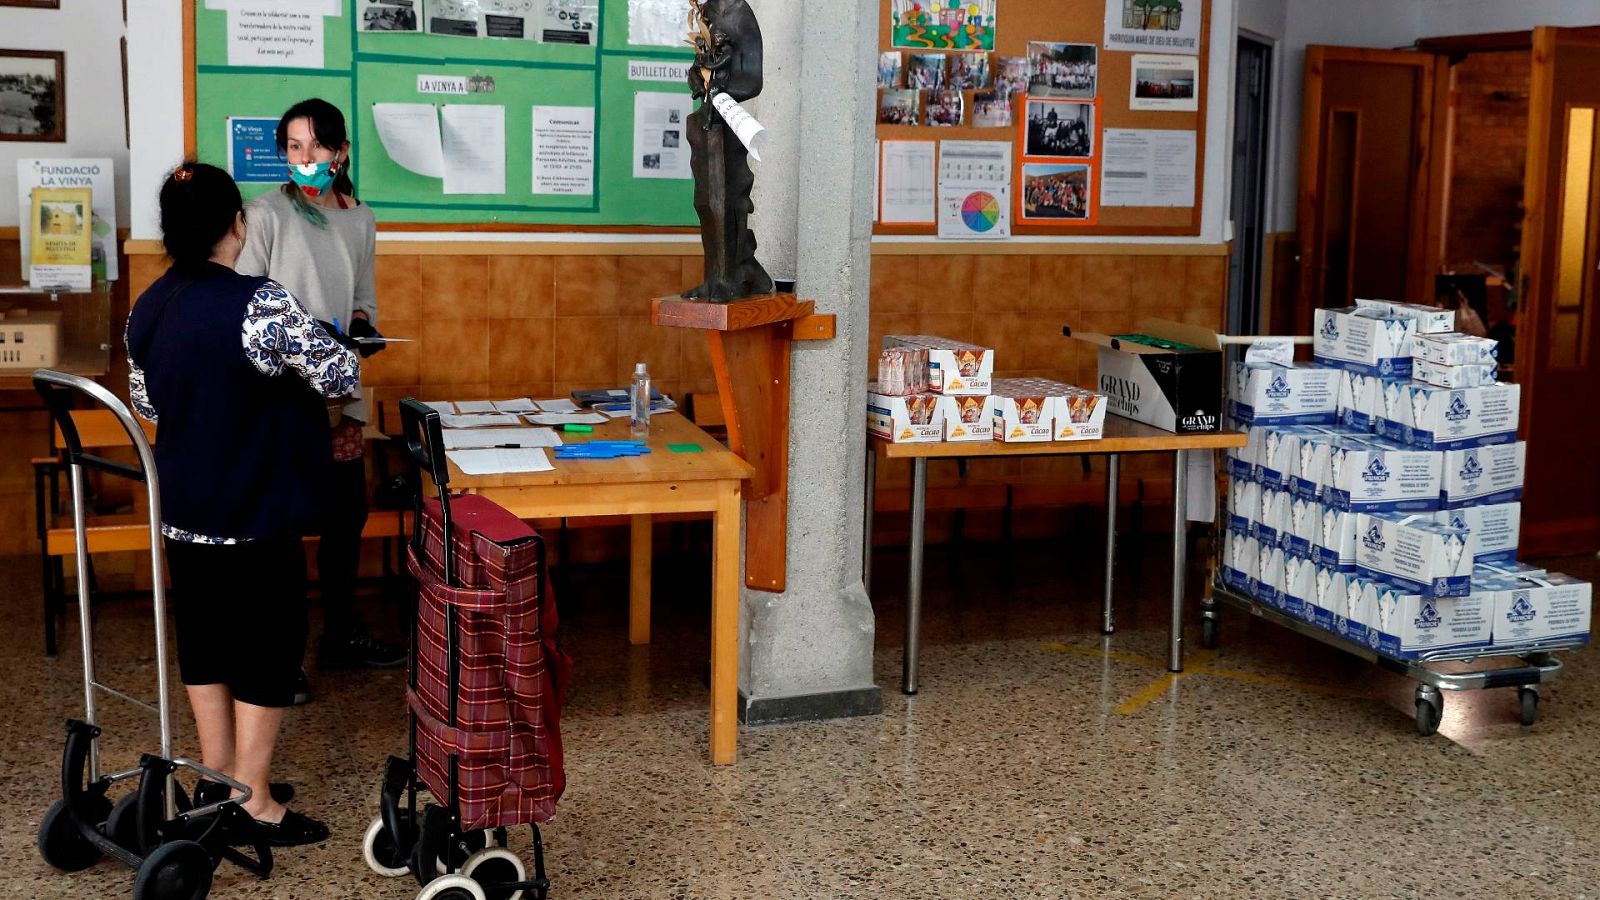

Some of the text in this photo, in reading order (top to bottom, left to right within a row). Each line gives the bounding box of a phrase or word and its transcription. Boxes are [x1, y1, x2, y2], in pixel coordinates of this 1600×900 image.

[669, 68, 682, 78] DEL
[420, 80, 430, 91] LA
[432, 81, 456, 93] VINYA
[458, 82, 464, 93] A
[40, 165, 100, 175] FUNDACIÓ
[41, 177, 93, 185] LA VINYA
[969, 380, 989, 388] Cacao
[1101, 374, 1140, 401] GRAND
[1117, 398, 1139, 416] chips
[1182, 415, 1215, 425] GRAND
[920, 428, 940, 436] Cacao
[1196, 423, 1215, 431] chips
